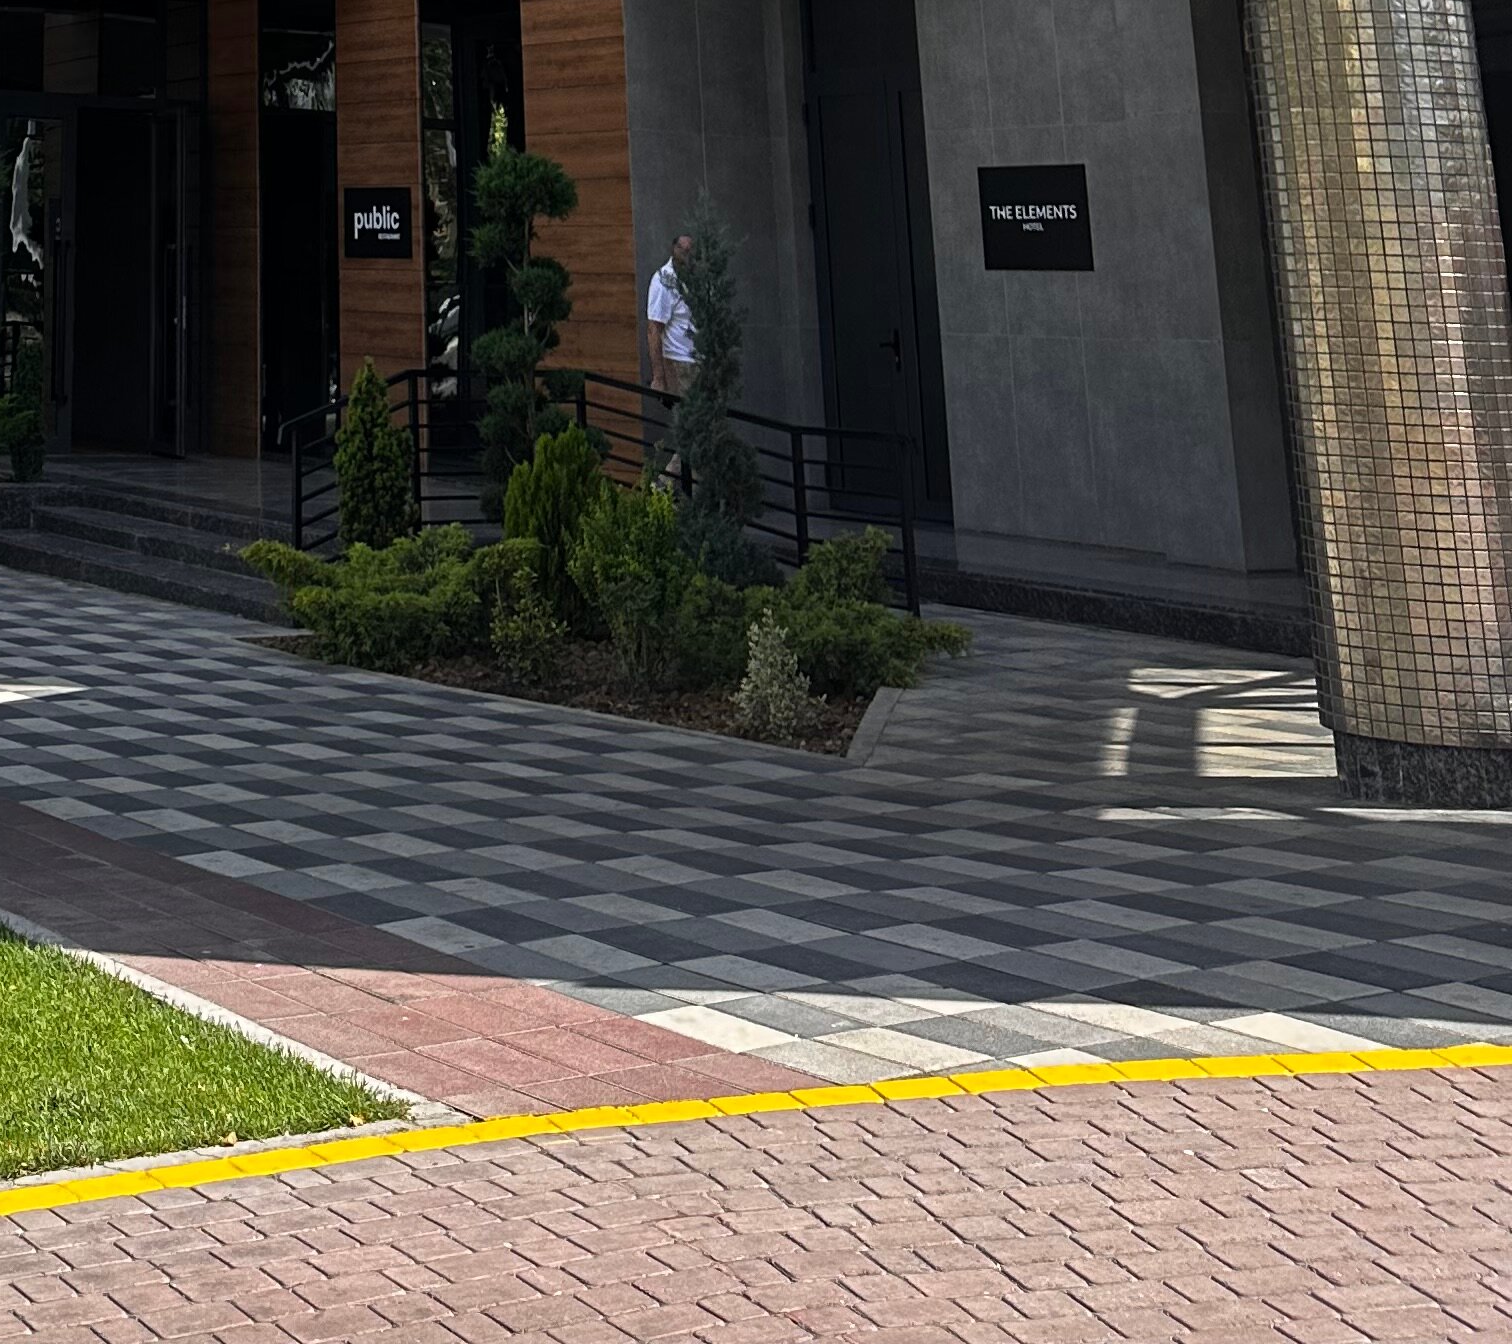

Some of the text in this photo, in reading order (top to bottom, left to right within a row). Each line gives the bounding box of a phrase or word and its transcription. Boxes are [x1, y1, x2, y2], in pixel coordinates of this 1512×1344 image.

[353, 205, 400, 240] public
[989, 204, 1077, 220] THE ELEMENTS
